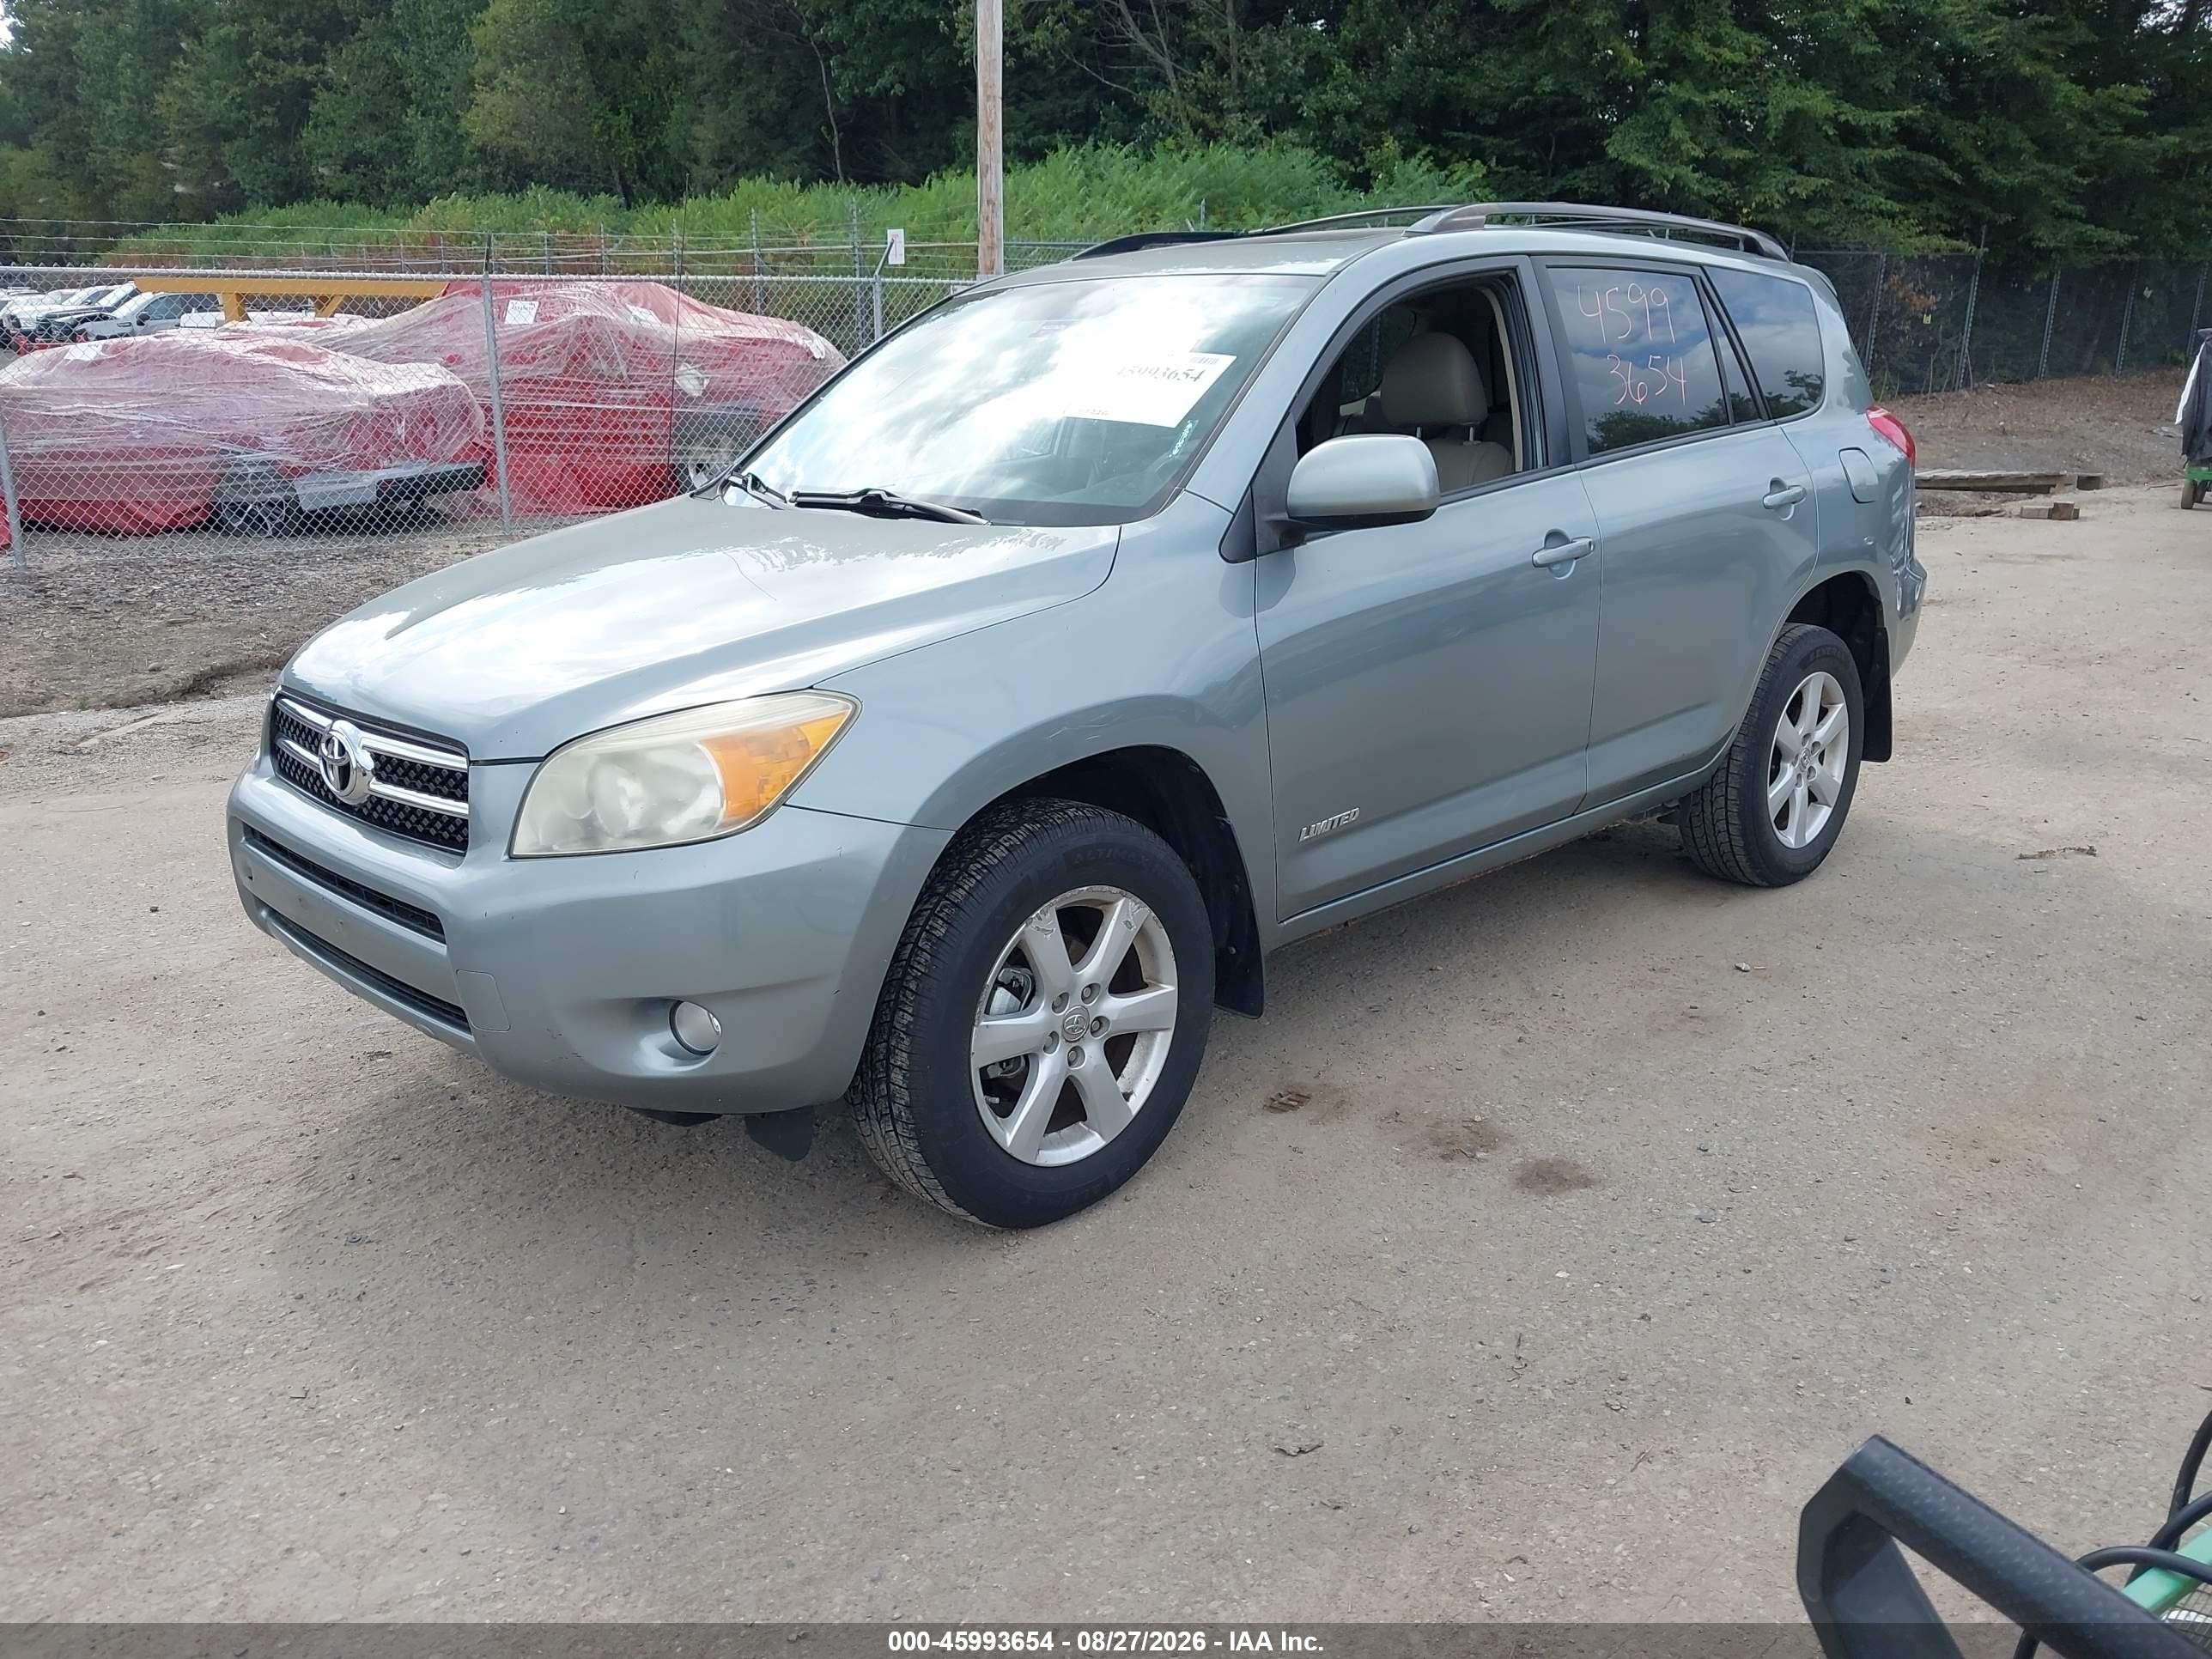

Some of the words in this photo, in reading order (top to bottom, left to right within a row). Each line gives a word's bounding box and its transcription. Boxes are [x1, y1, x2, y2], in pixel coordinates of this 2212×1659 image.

[1577, 283, 1676, 344] 4599
[1606, 354, 1687, 406] 3654
[1298, 806, 1360, 842] LIMITED
